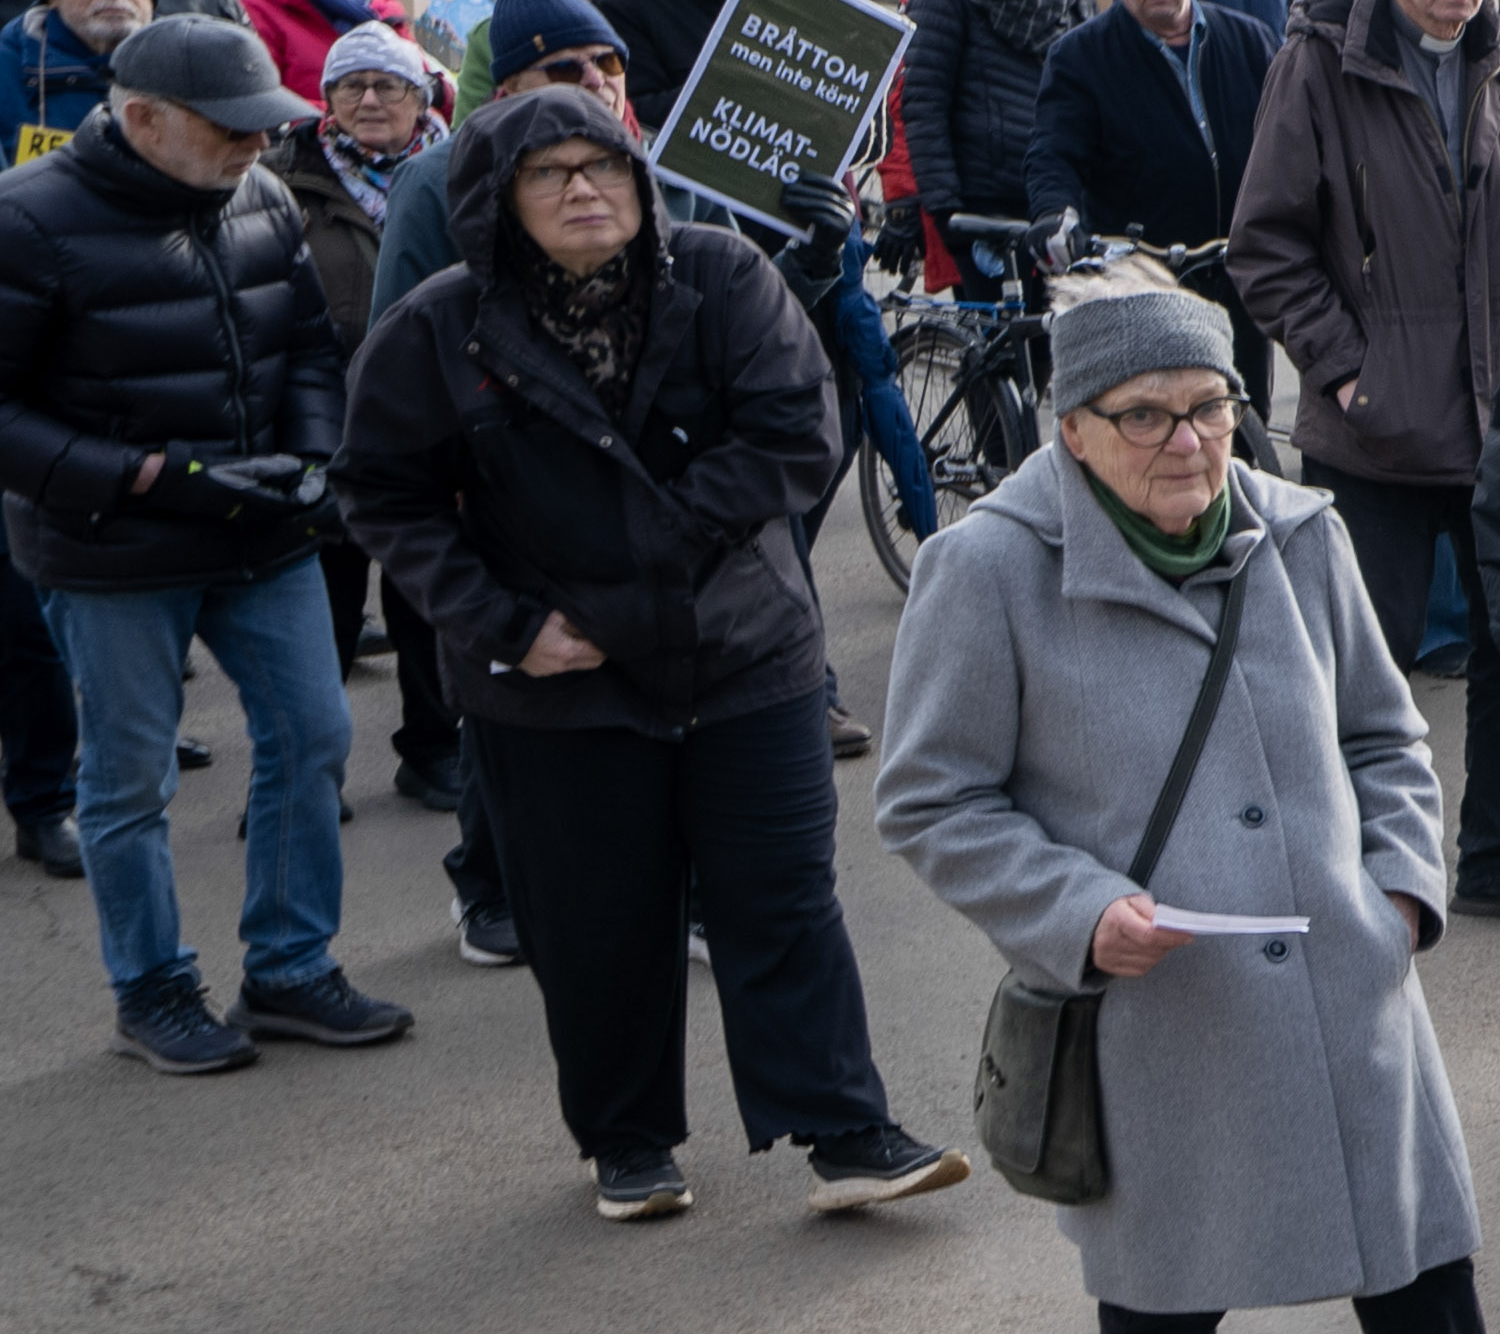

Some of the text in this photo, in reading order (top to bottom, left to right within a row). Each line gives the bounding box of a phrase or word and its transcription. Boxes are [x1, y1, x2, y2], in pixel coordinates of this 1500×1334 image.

[730, 41, 861, 114] men inte kört!
[741, 13, 869, 93] BRÅTTOM
[689, 117, 801, 185] NÖDLÄG
[712, 96, 818, 159] KLIMAT-
